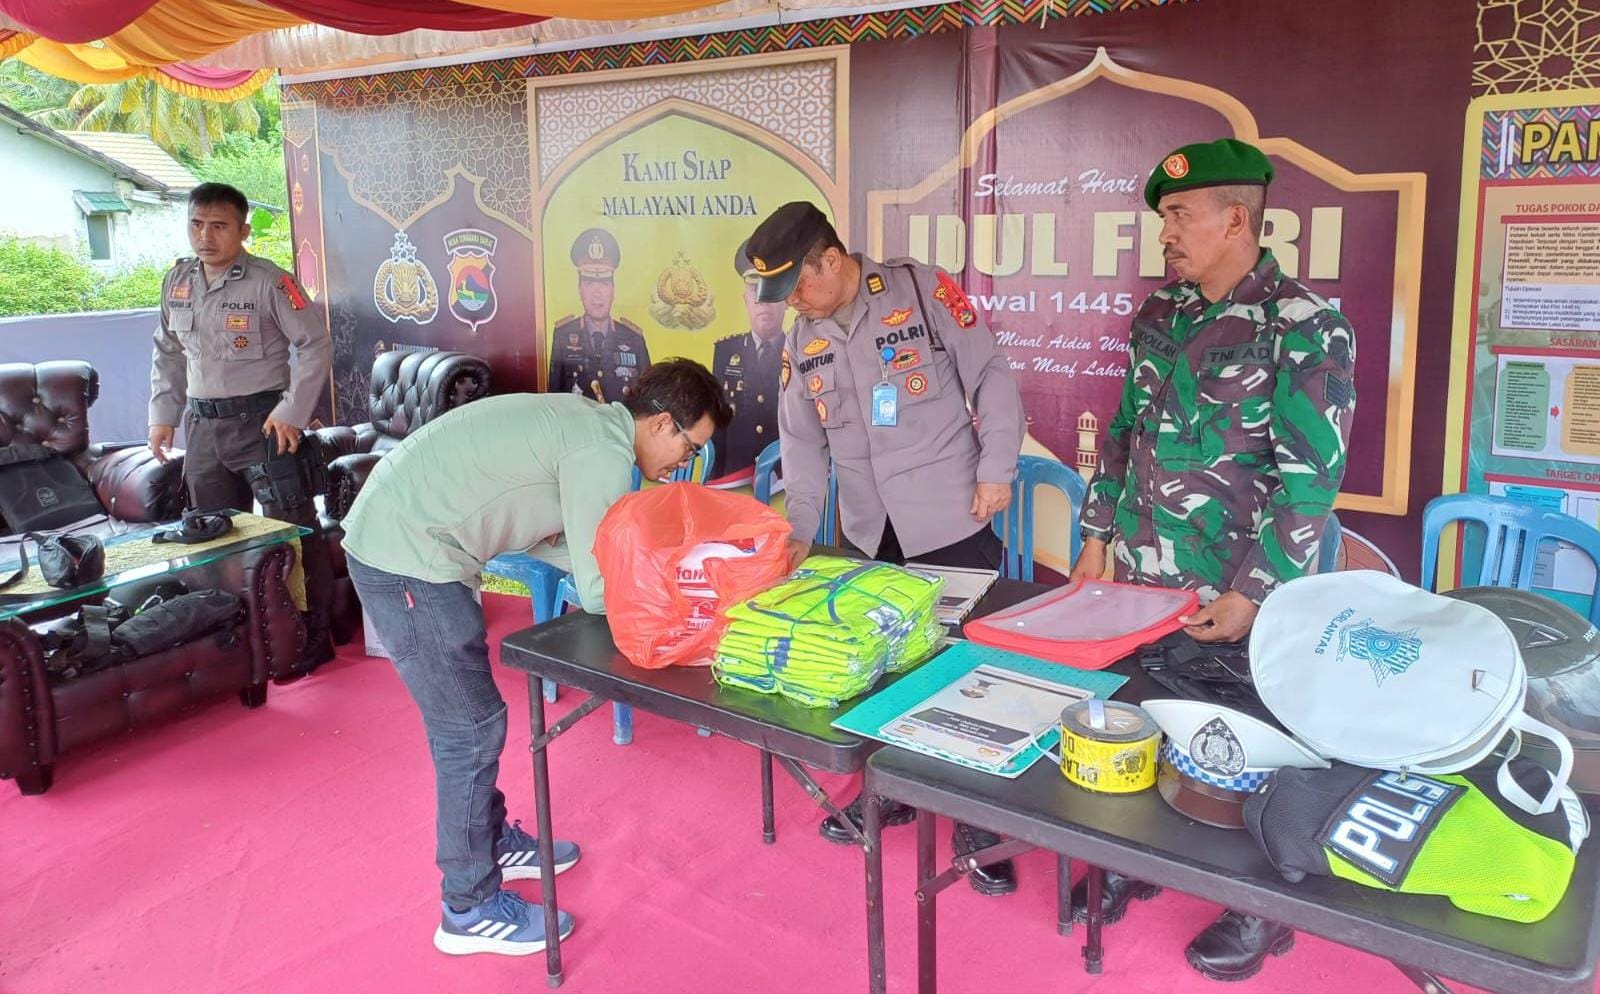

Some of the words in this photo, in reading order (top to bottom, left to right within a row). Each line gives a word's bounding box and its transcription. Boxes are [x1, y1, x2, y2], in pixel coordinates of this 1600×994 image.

[974, 173, 1069, 197] Selamat
[1078, 168, 1139, 195] Hari
[602, 195, 696, 216] MALAYANI
[701, 194, 758, 216] ANDA
[1516, 203, 1549, 213] TUGAS
[1550, 203, 1586, 213] POKOK
[908, 212, 1069, 277] IDUL
[1092, 206, 1343, 280] FIRI
[220, 301, 255, 311] POLRI
[1050, 291, 1133, 316] 1445
[875, 323, 926, 350] POLRI
[995, 330, 1044, 348] Minal
[1046, 333, 1092, 350] Aidin
[1550, 337, 1597, 348] SASARAN
[1209, 351, 1235, 363] TNI
[1241, 347, 1271, 359] AD
[1032, 356, 1079, 378] Maaf
[1081, 360, 1128, 378] Lahir
[1545, 469, 1581, 480] TARGET
[1314, 606, 1357, 656] KORLANTAS
